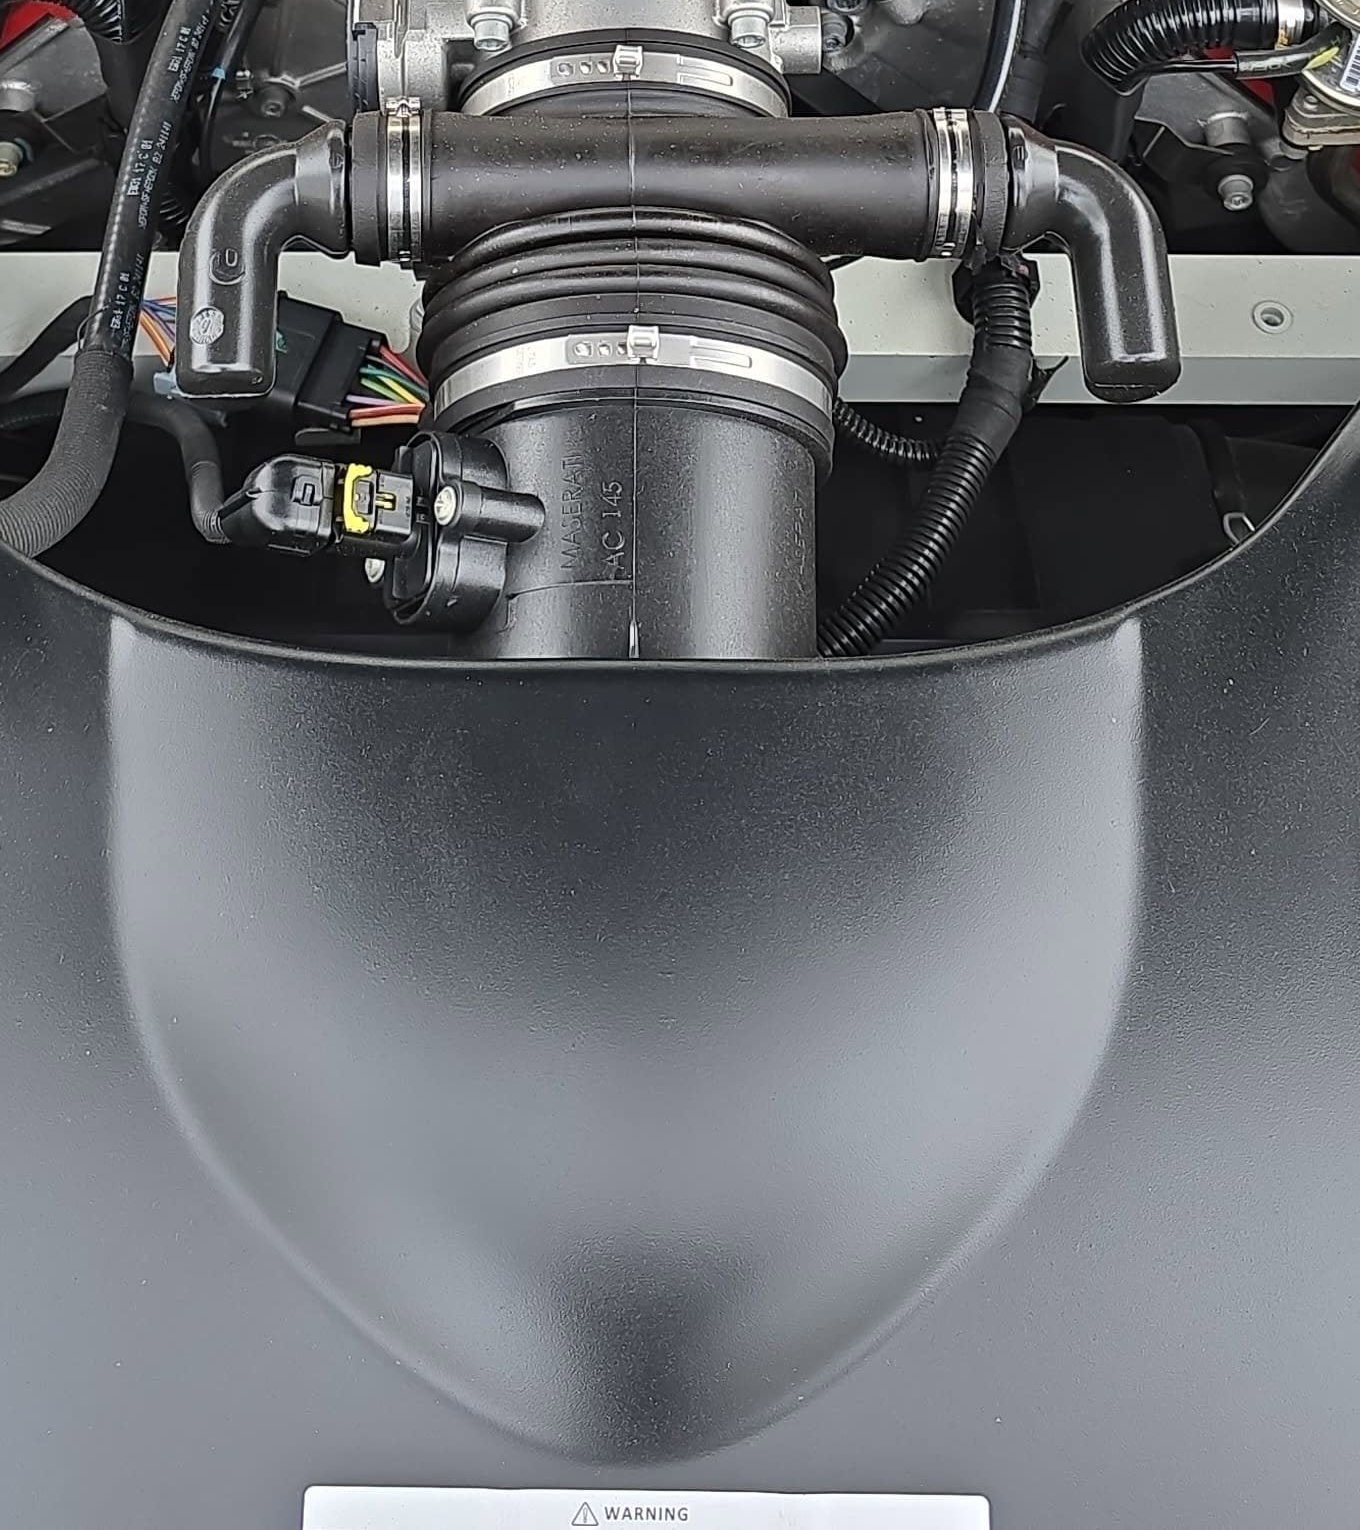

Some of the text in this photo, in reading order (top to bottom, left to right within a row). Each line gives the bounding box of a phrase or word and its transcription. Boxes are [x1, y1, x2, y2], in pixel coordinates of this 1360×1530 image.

[560, 454, 584, 570] MASERATI
[602, 530, 625, 570] AC
[604, 1506, 689, 1522] WARNING
